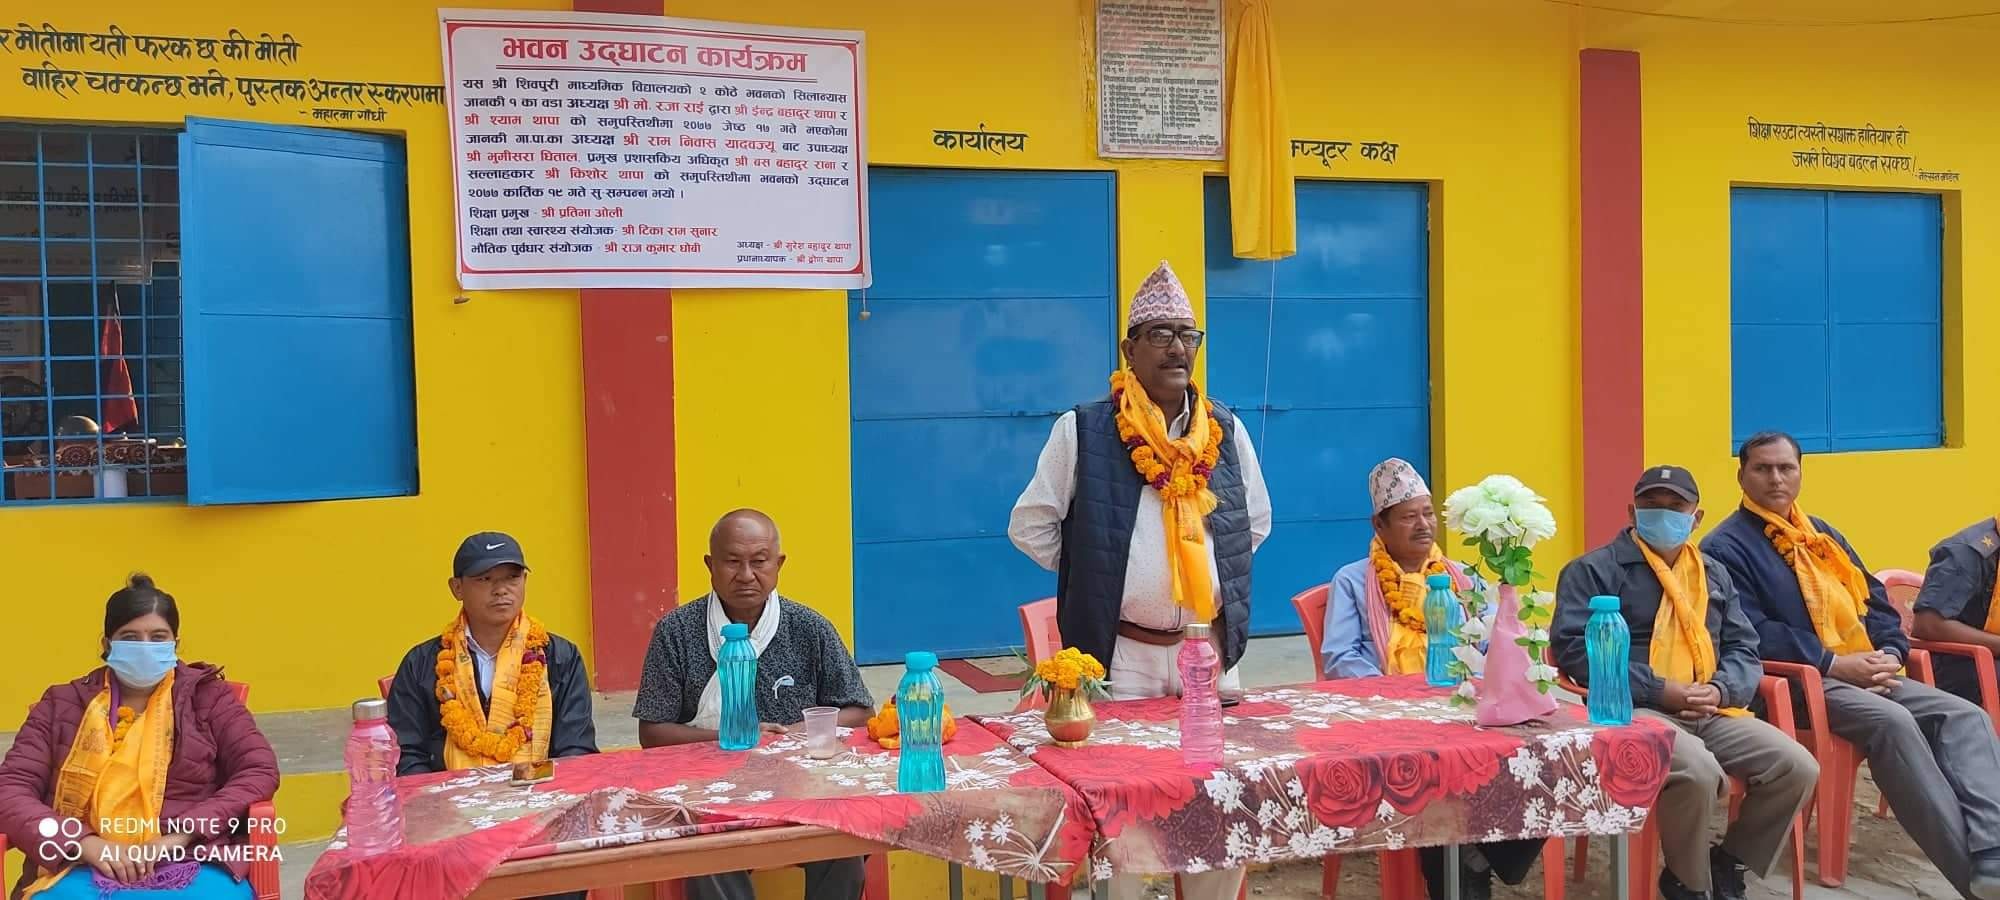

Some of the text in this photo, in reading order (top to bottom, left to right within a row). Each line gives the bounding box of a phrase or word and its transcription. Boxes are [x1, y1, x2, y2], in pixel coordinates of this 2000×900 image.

[13, 22, 89, 57] मोतीमा
[89, 24, 131, 60] यती
[131, 35, 192, 62] फरक
[193, 38, 220, 63] छ
[220, 28, 254, 61] की
[255, 33, 303, 66] मोती
[503, 38, 809, 73] भवन उद्घाटन कार्यक्रम
[235, 77, 307, 106] पुस्तक
[308, 78, 367, 105] अन्तर
[463, 78, 484, 91] यस
[492, 77, 507, 90] श्री
[516, 77, 559, 92] शिवपुरी
[567, 79, 624, 92] माध्यमिक
[632, 80, 692, 95] विद्यालयको
[714, 85, 738, 98] कोठे
[746, 88, 785, 100] भवनको
[793, 89, 848, 103] सिलान्यास
[464, 95, 505, 107] जानकी
[509, 98, 517, 107] १
[521, 98, 537, 108] का
[541, 98, 563, 108] वडा
[567, 98, 609, 110] अध्यक्ष
[613, 97, 629, 110] श्री
[656, 101, 679, 113] रजा
[708, 103, 731, 116] द्वारा
[735, 105, 748, 117] श्री
[814, 109, 836, 120] थापा
[840, 110, 848, 121] र
[464, 113, 479, 126] श्री
[490, 115, 522, 126] श्याम
[532, 115, 560, 126] थापा
[570, 114, 587, 126] को
[683, 120, 712, 131] २०७७
[756, 123, 770, 134] १७
[780, 122, 797, 135] गते
[806, 123, 848, 137] भएकोमा
[465, 132, 507, 144] जानकी
[571, 134, 615, 146] अध्यक्ष
[623, 132, 639, 146] श्री
[648, 135, 671, 147] राम
[680, 134, 716, 149] निवास
[933, 122, 1029, 156] कार्यालय
[1895, 125, 1910, 149] हो
[467, 150, 480, 162] श्री
[587, 152, 617, 164] प्रमुख
[735, 155, 748, 168] श्री
[814, 160, 836, 170] राना
[841, 161, 849, 171] र
[1360, 141, 1399, 164] कक्ष
[467, 168, 535, 180] सल्लाहकार
[545, 167, 560, 180] श्री
[570, 167, 608, 181] किशोर
[618, 169, 644, 180] थापा
[654, 169, 670, 181] को
[760, 172, 799, 185] भवनको
[468, 188, 498, 198] २०७७
[503, 185, 544, 198] कार्तिक
[567, 186, 586, 198] गते
[652, 187, 675, 199] भयो
[469, 206, 497, 219] शिक्षा
[501, 208, 529, 221] प्रमुख
[541, 206, 555, 218] श्री
[559, 206, 591, 219] प्रतिमा
[595, 206, 623, 218] ओली
[470, 224, 498, 237] शिक्षा
[502, 226, 523, 236] तथा
[622, 224, 635, 236] श्री
[638, 224, 663, 236] टिका
[668, 226, 686, 237] राम
[690, 226, 719, 238] सुनार
[549, 241, 592, 253] संयोजक
[604, 241, 617, 253] श्री
[621, 243, 642, 254] राज
[646, 243, 676, 255] कुमार
[773, 239, 783, 250] श्री
